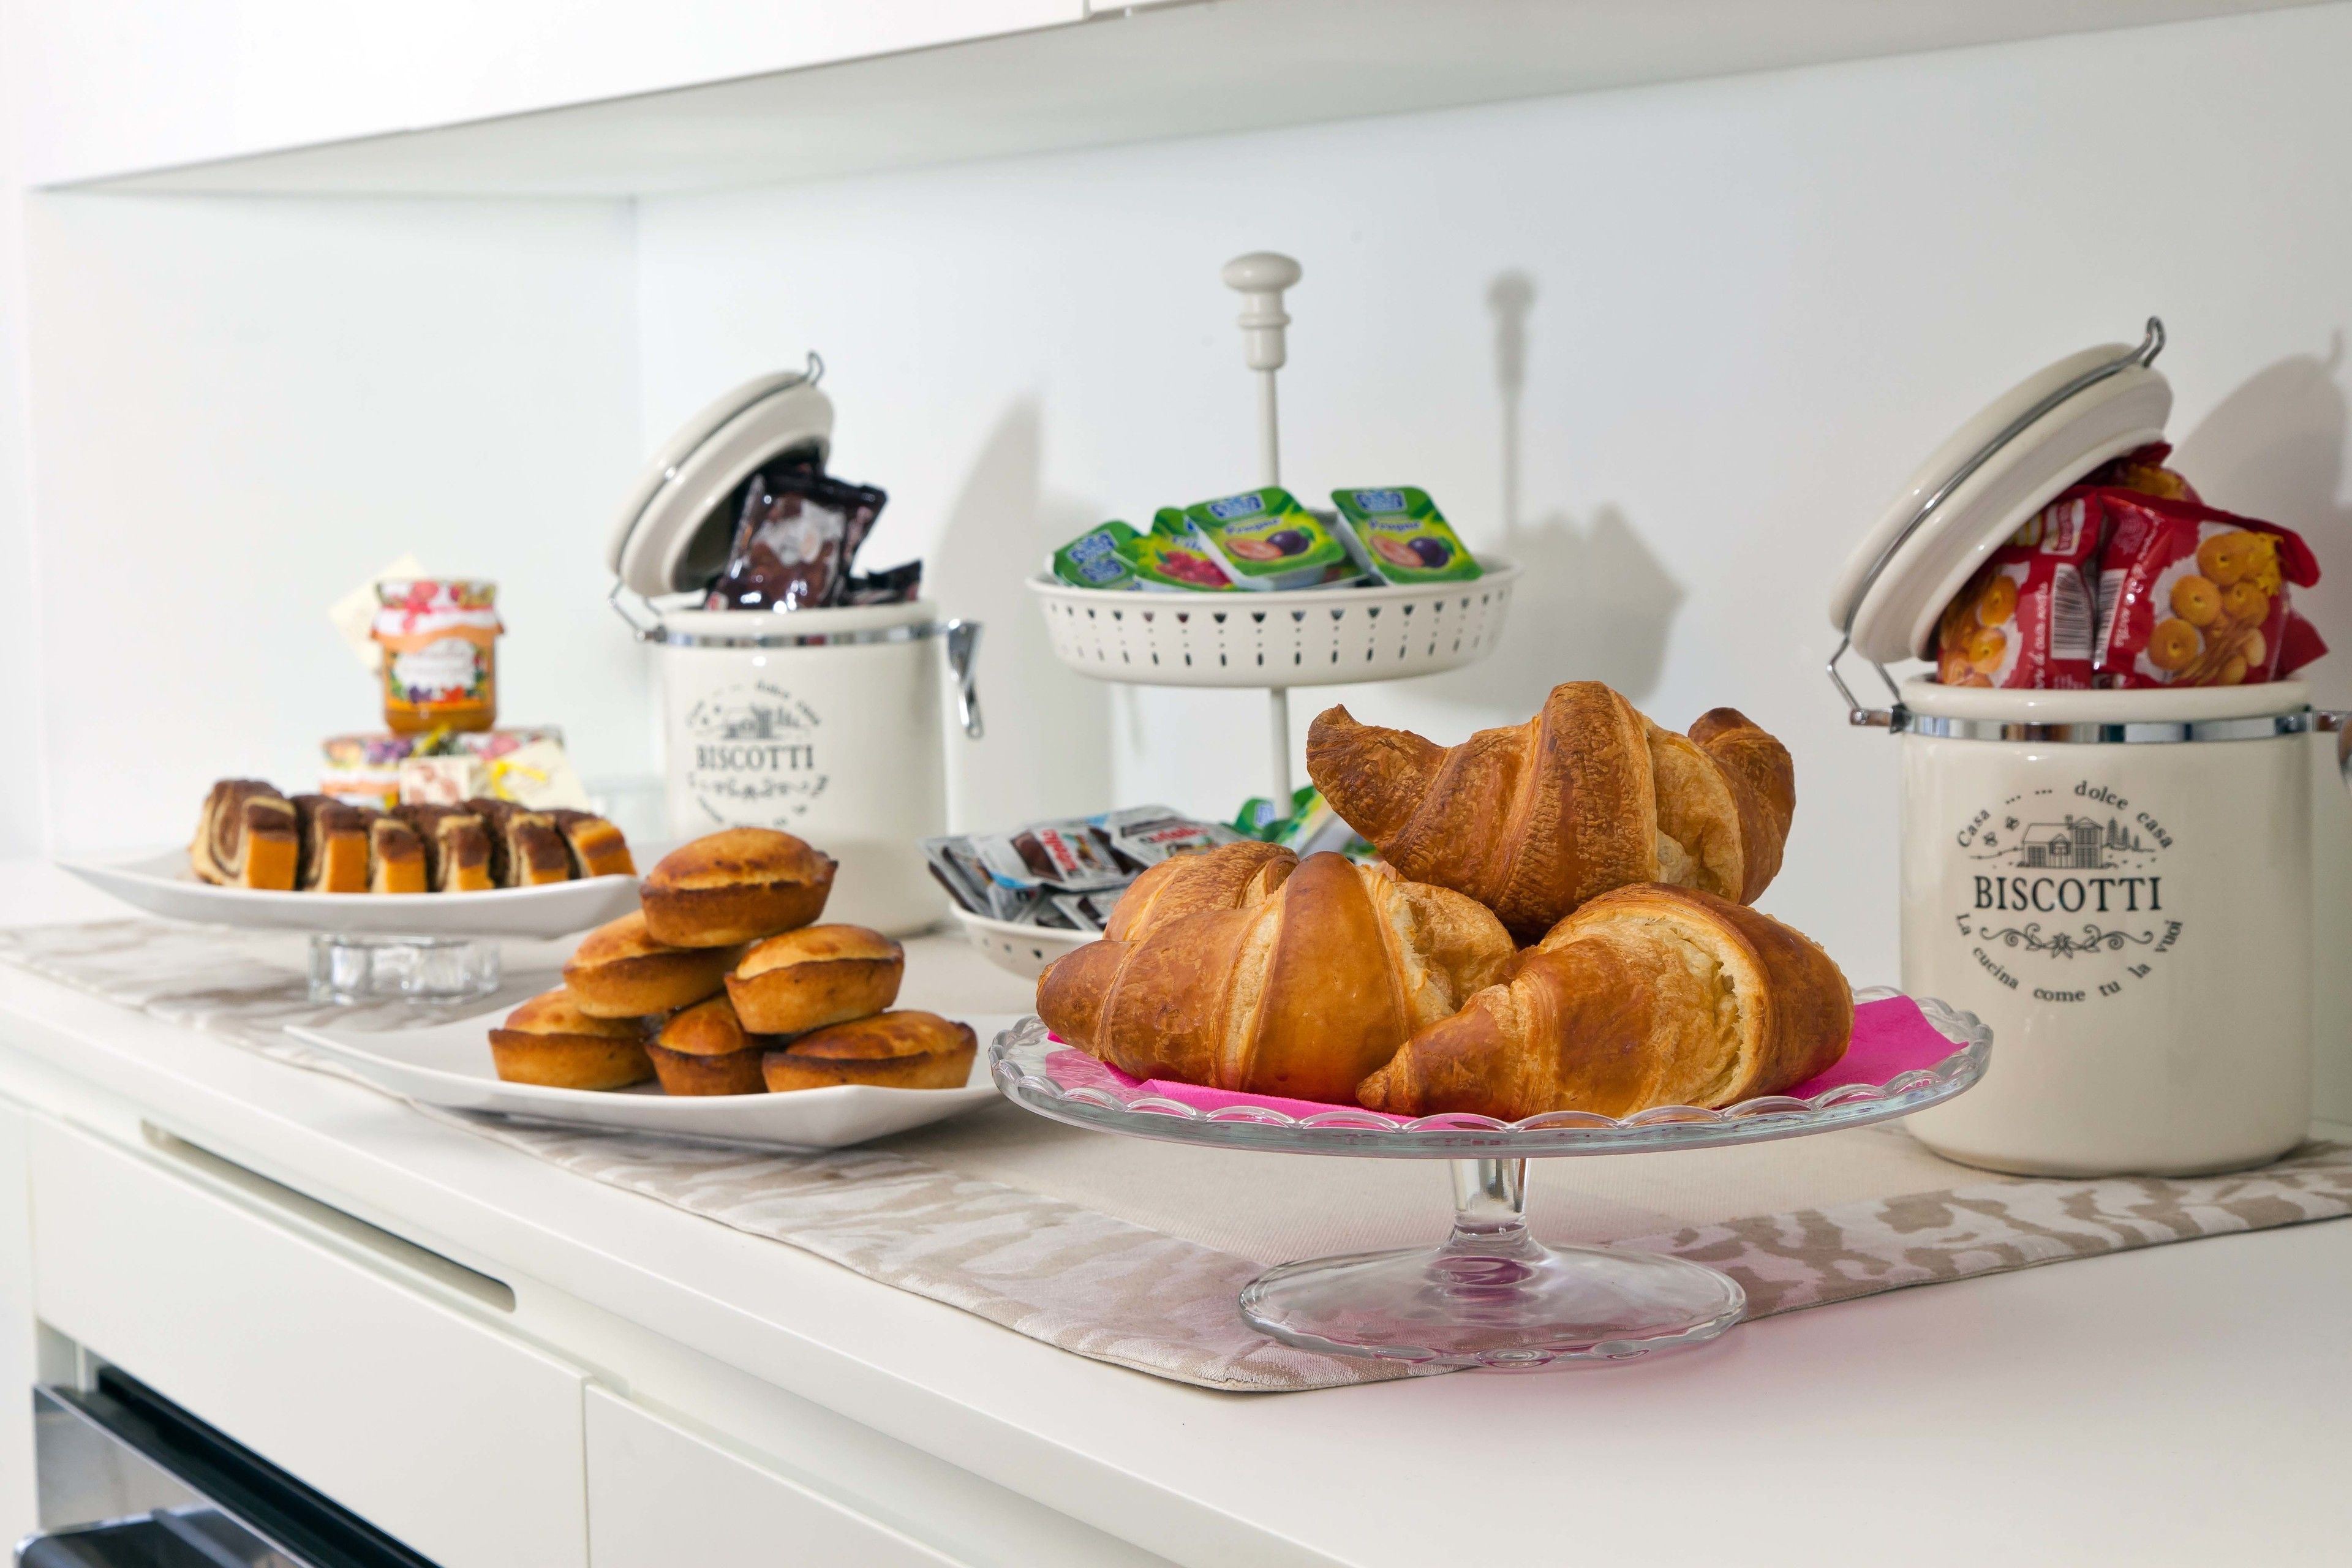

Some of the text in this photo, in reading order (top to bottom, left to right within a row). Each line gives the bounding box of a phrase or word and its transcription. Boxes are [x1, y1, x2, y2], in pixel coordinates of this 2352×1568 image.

[696, 744, 815, 771] BISCOTTI
[1957, 809, 1991, 847] Casa
[2074, 780, 2128, 810] dolce
[2136, 812, 2173, 849] casa
[1973, 875, 2162, 913] BISCOTTI
[1956, 913, 2183, 1002] La cucina come tu la vuoi
